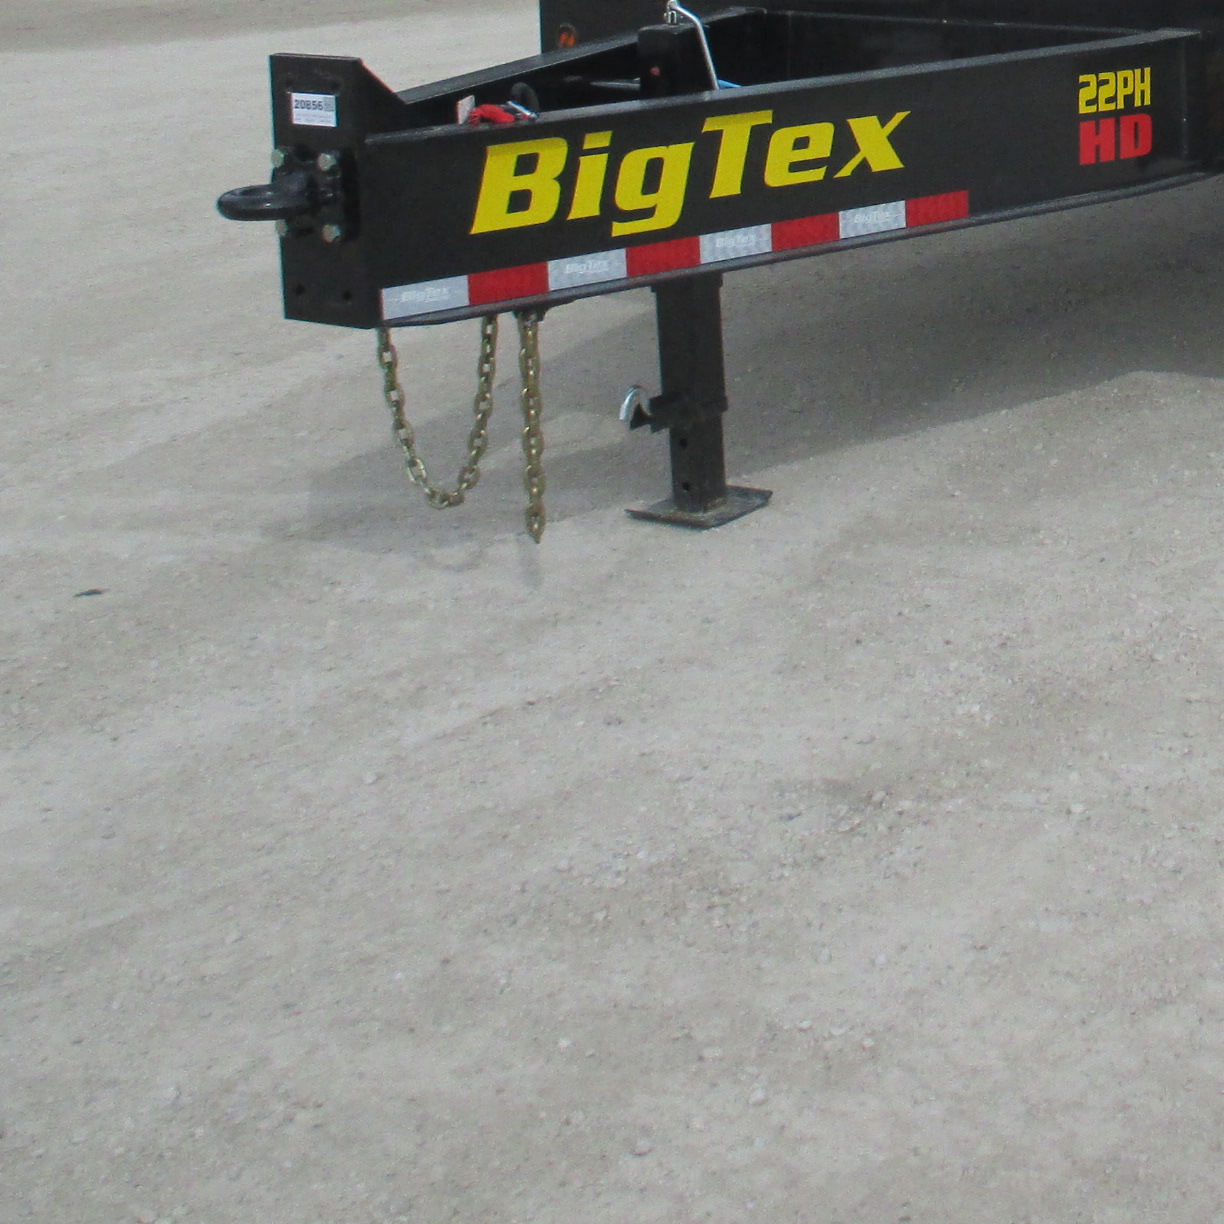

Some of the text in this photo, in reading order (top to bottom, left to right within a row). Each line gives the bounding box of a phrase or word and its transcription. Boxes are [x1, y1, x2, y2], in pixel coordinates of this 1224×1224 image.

[1079, 67, 1151, 114] 22PH
[1079, 113, 1153, 165] HD
[469, 110, 911, 237] BigTex
